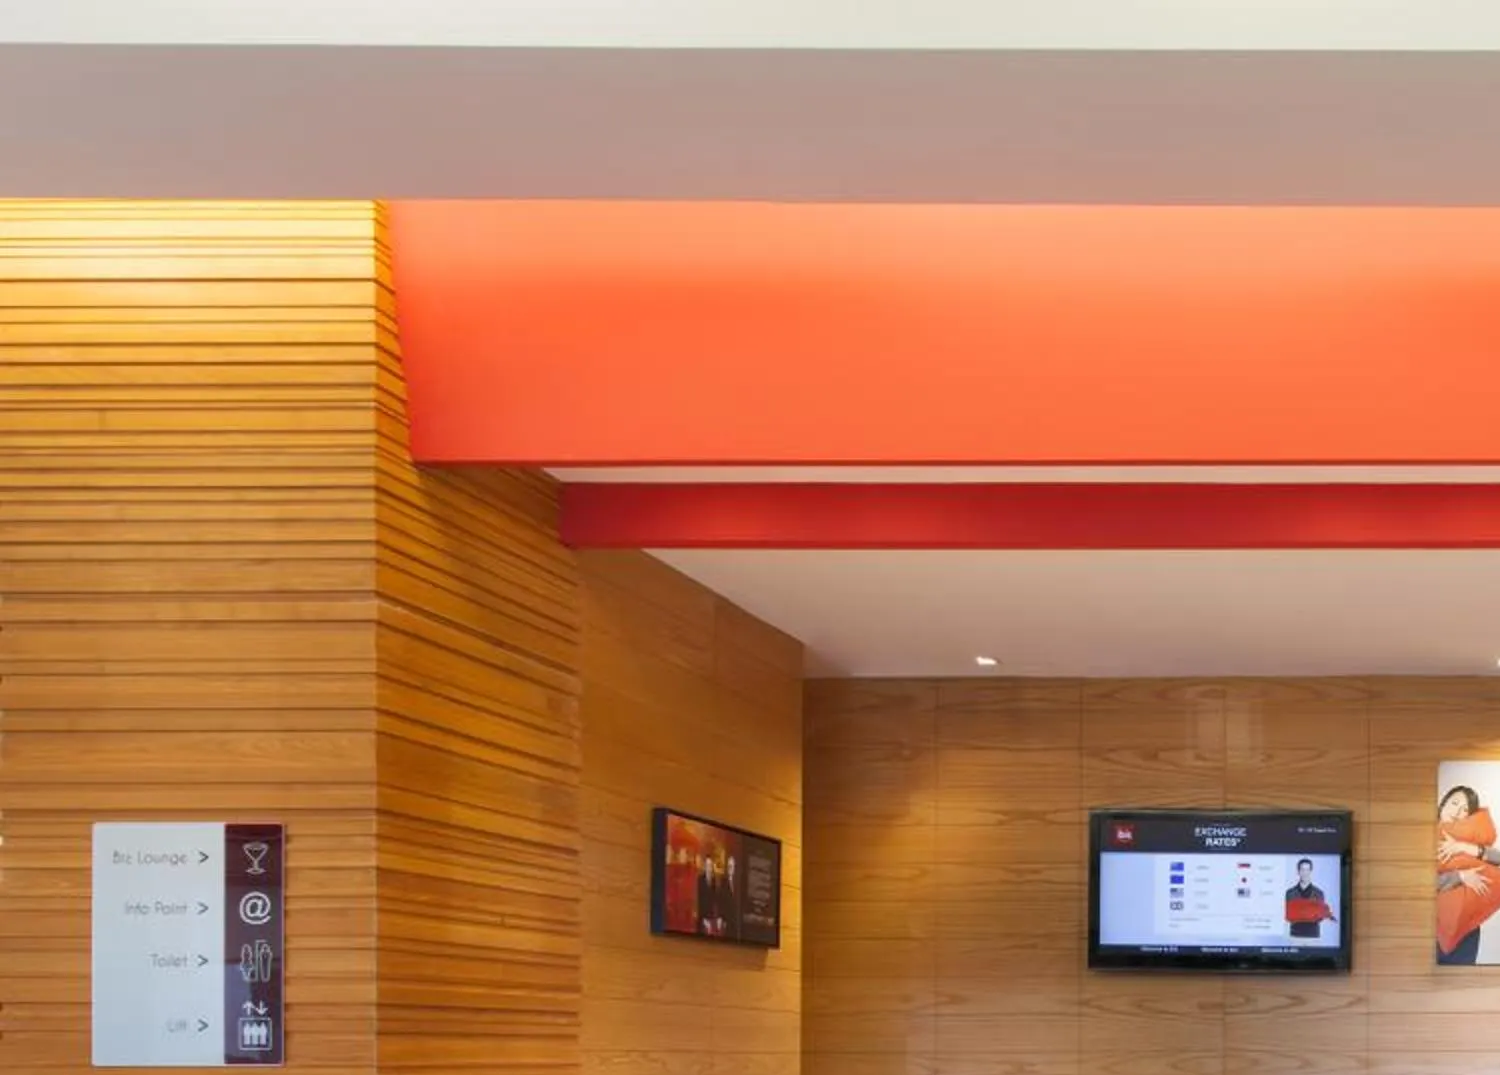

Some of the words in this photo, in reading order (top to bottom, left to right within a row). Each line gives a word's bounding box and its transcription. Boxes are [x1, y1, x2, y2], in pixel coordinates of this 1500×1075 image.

[1194, 826, 1247, 837] EXCHANGE
[137, 850, 187, 867] Lounge
[124, 900, 150, 916] Info
[154, 900, 187, 915] Point
[150, 953, 188, 968] Toilet
